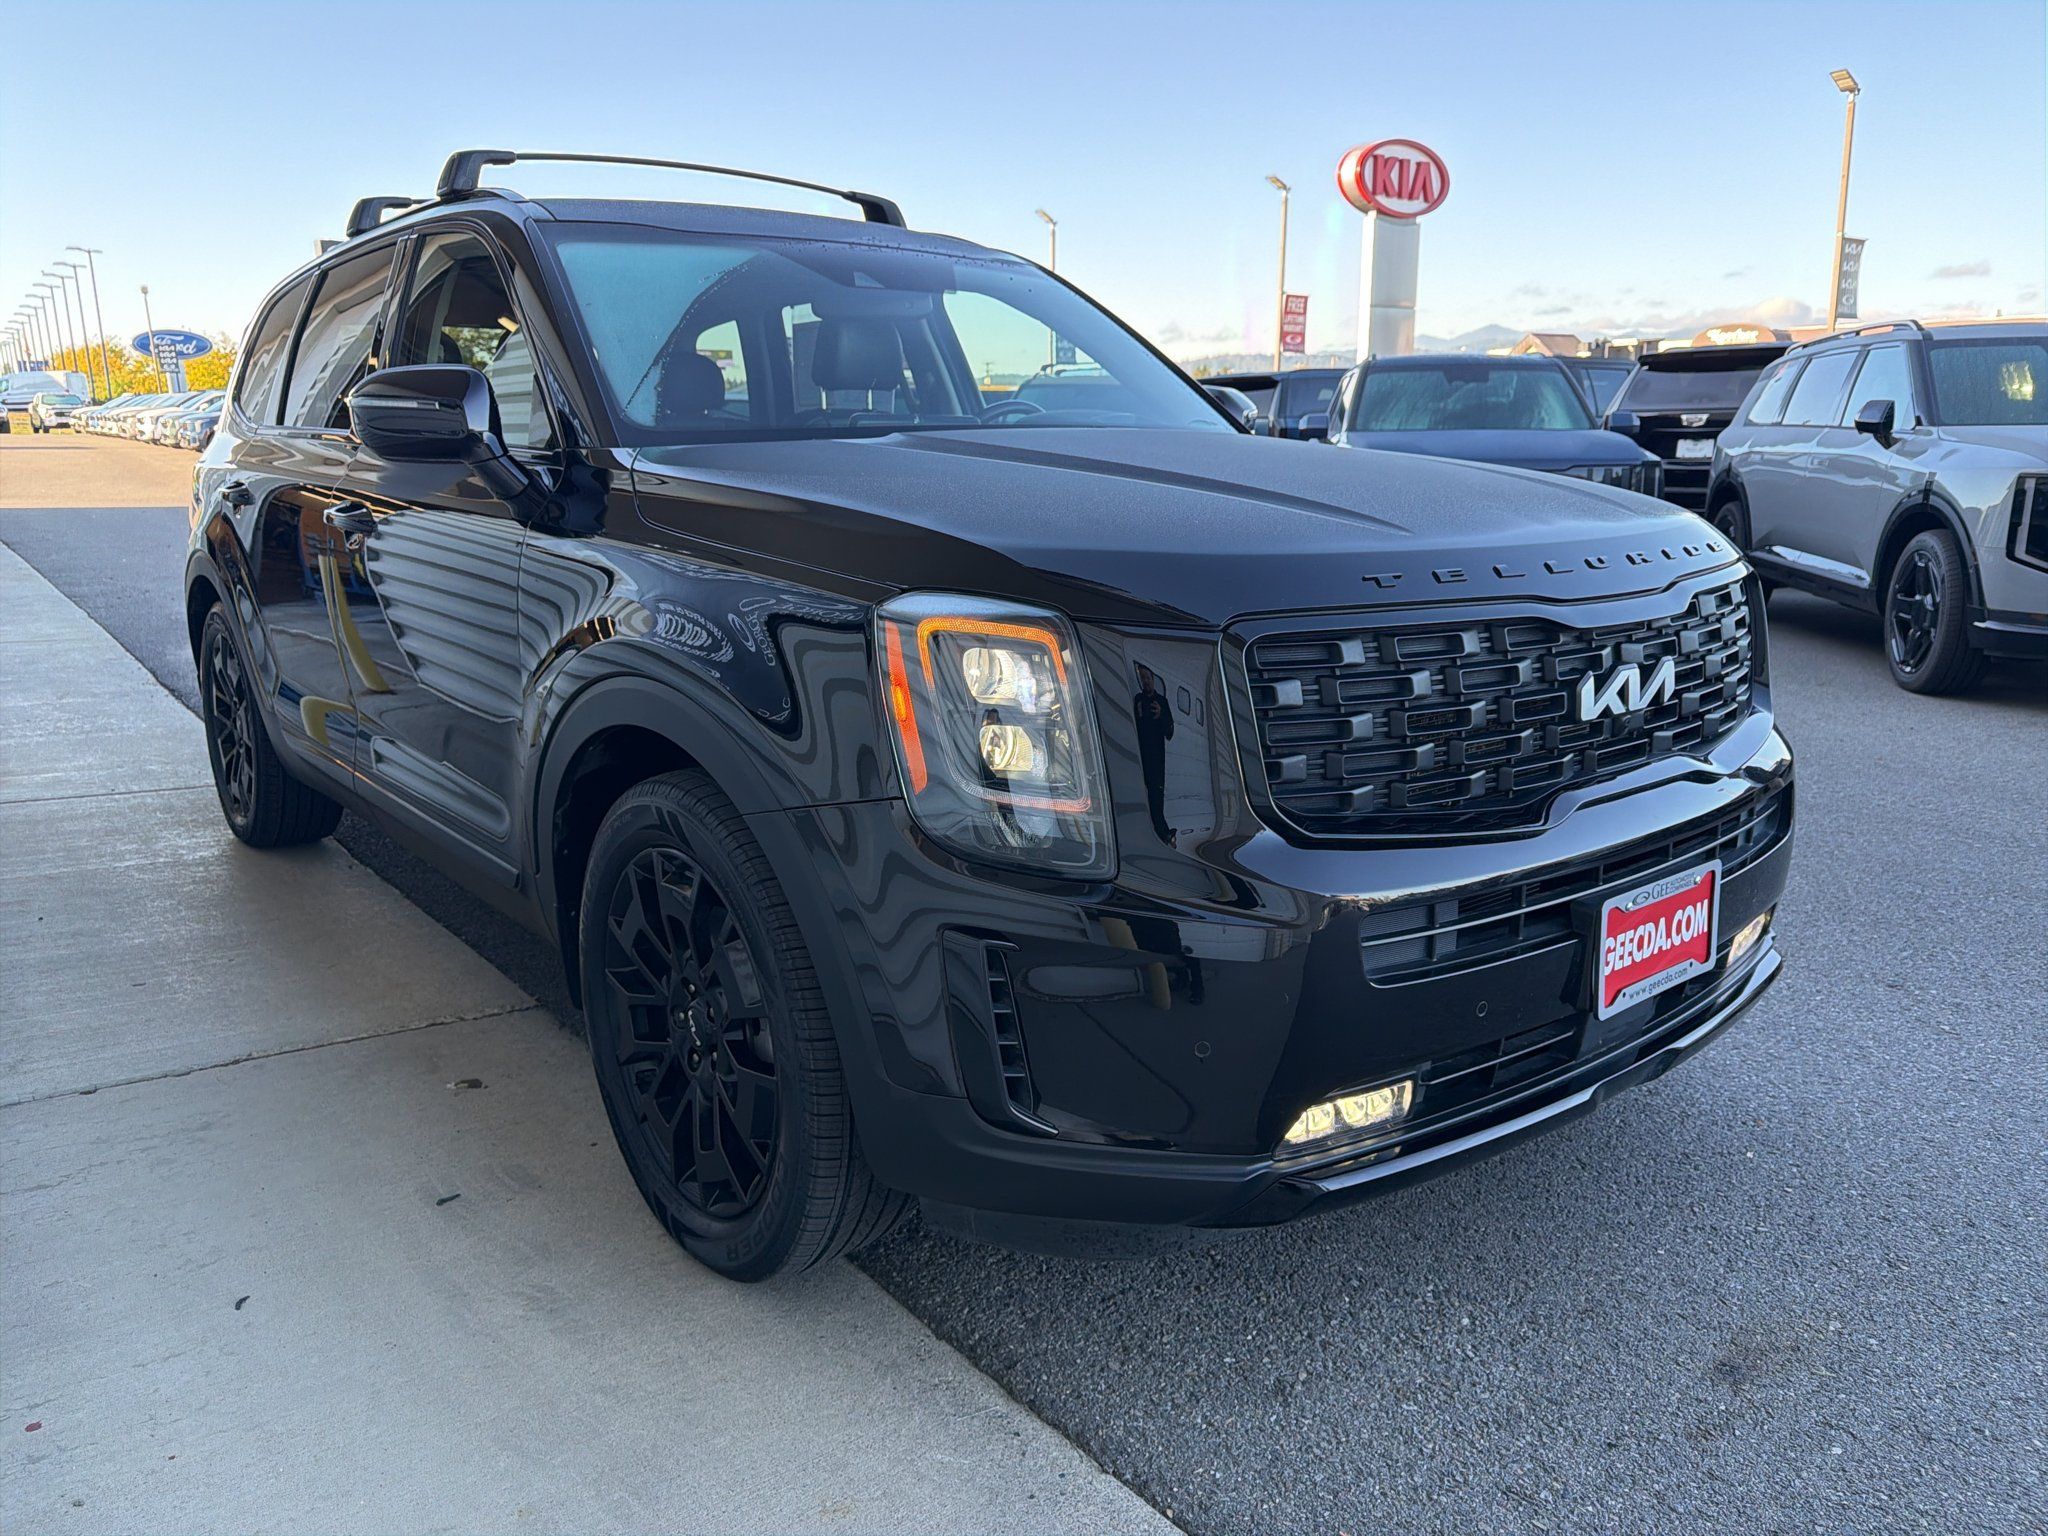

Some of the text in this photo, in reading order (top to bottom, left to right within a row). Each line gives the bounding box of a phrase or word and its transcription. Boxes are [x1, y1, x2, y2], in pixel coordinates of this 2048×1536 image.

[1371, 153, 1436, 204] KIA
[1361, 541, 1725, 589] TELLURIDE
[1576, 655, 1676, 722] KIA
[1604, 898, 1709, 976] GEECDA.COM
[1628, 966, 1689, 1001] www.geecda.com
